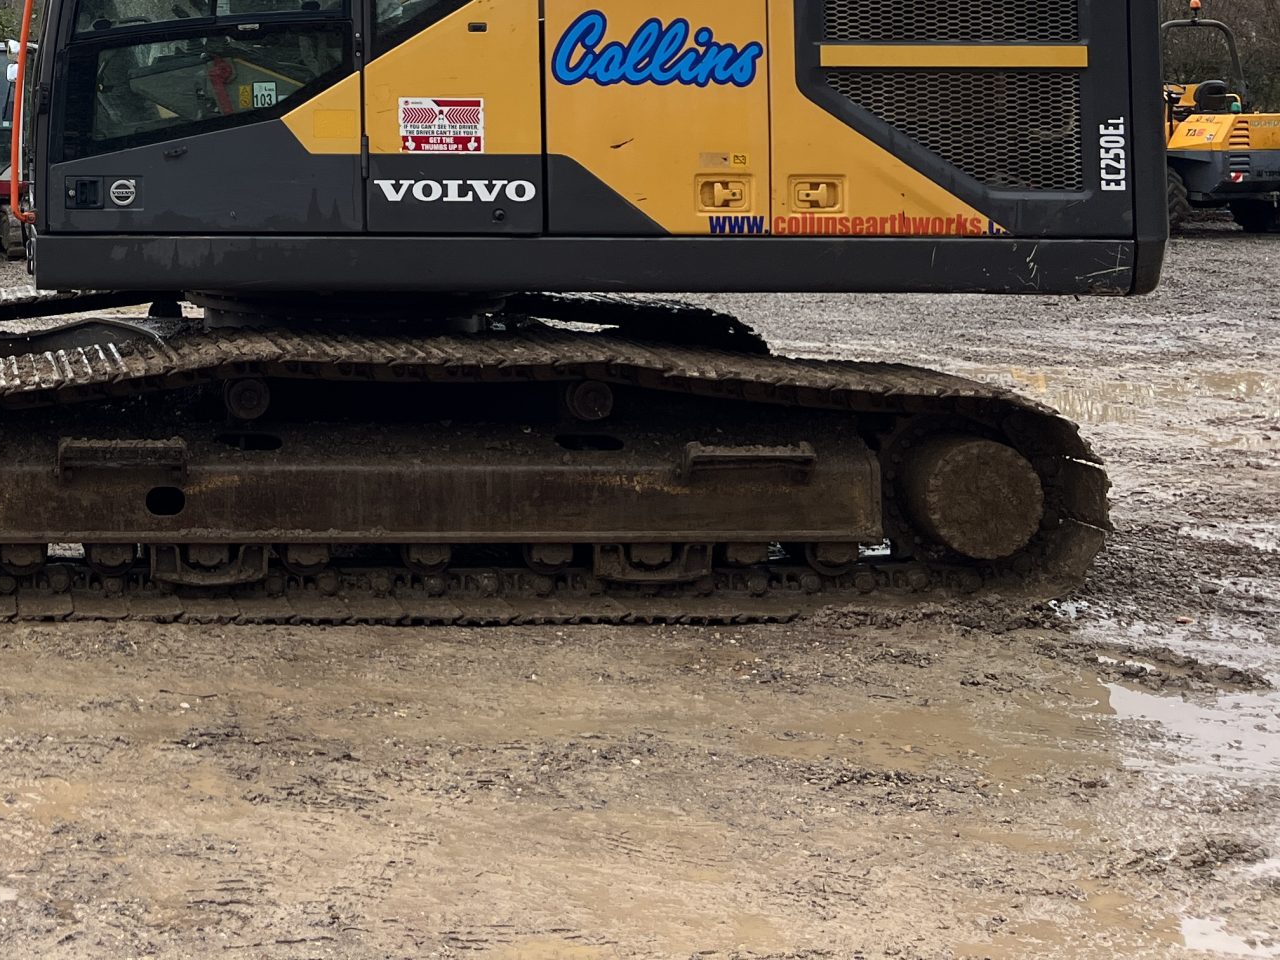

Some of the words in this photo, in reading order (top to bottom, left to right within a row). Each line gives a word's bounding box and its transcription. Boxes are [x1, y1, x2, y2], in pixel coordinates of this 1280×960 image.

[551, 9, 763, 87] Collins
[254, 93, 272, 107] 103
[1099, 116, 1126, 191] EC250EL
[373, 179, 536, 202] VOLVO
